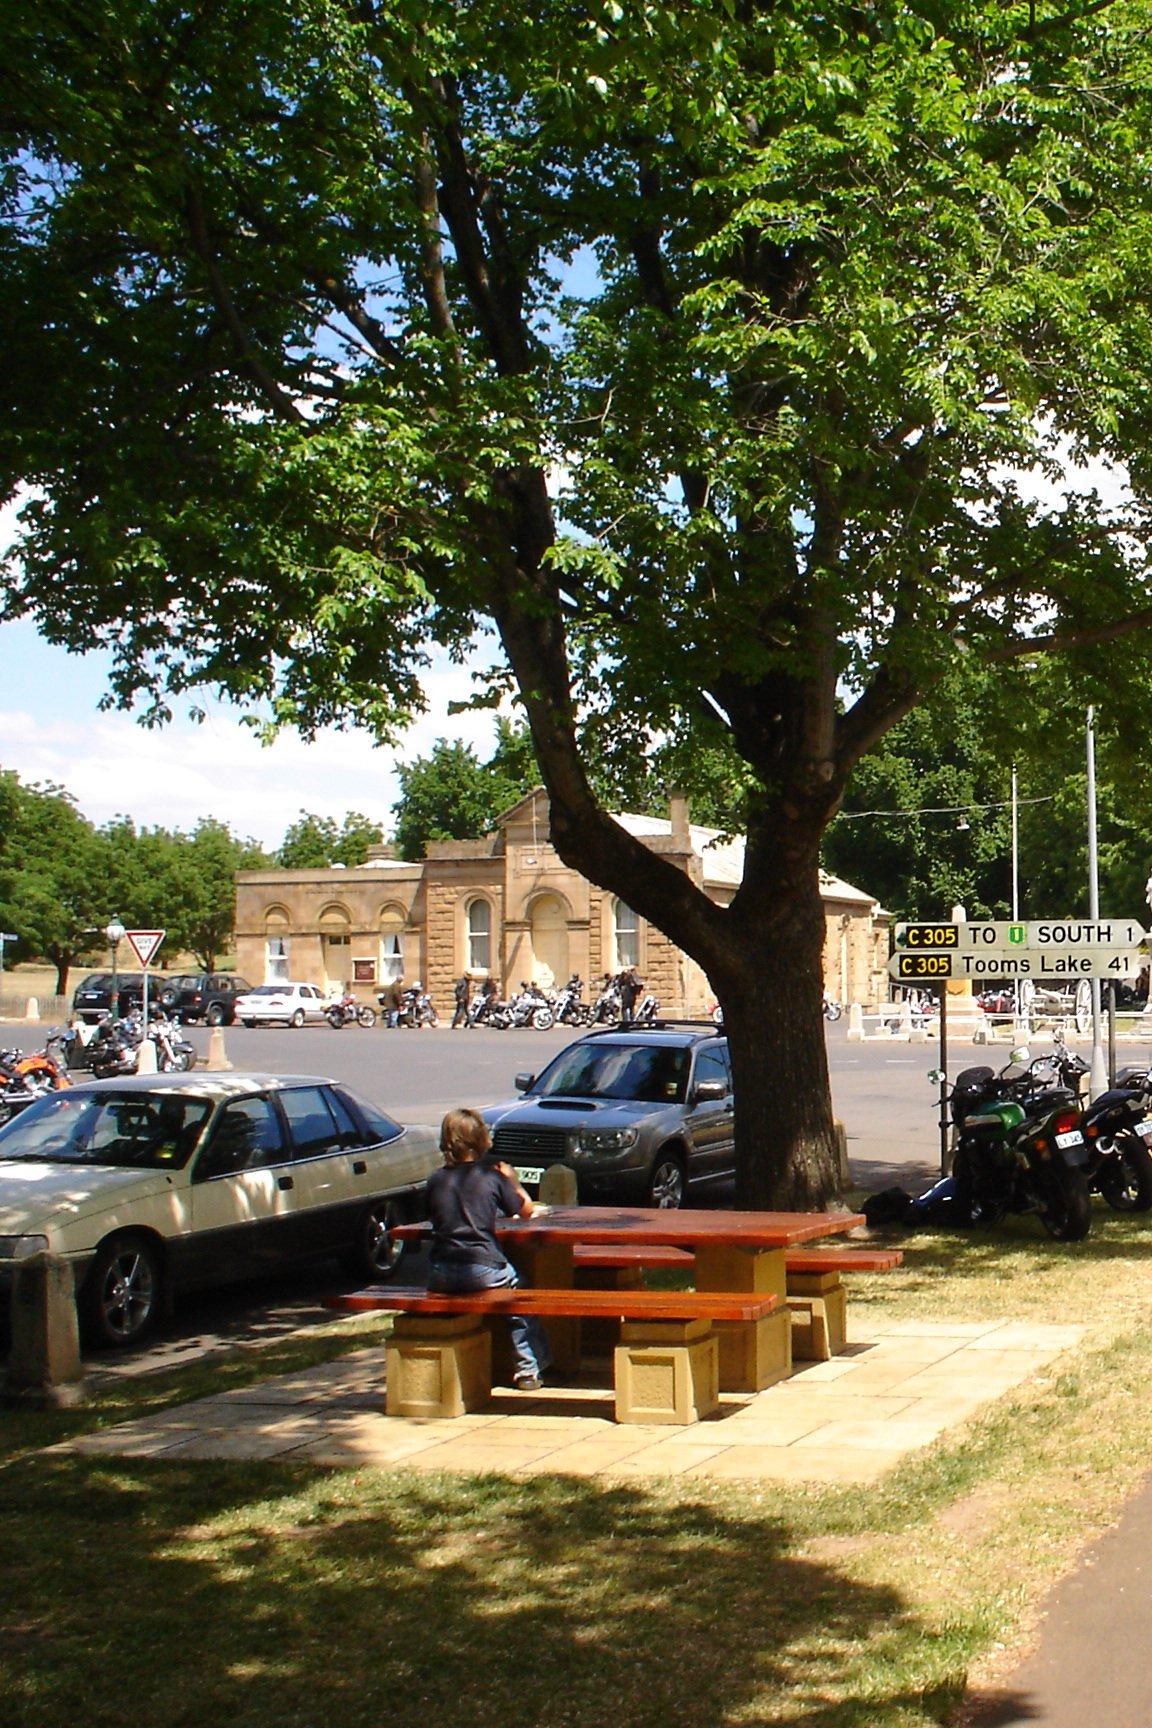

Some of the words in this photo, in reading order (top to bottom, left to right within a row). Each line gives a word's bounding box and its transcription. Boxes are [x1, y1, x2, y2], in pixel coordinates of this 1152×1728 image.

[968, 927, 997, 944] TO
[1037, 925, 1112, 943] SOUTH
[1126, 926, 1133, 942] 1
[962, 956, 1031, 973] Tooms
[1041, 955, 1093, 972] Lake
[1108, 956, 1129, 972] 41
